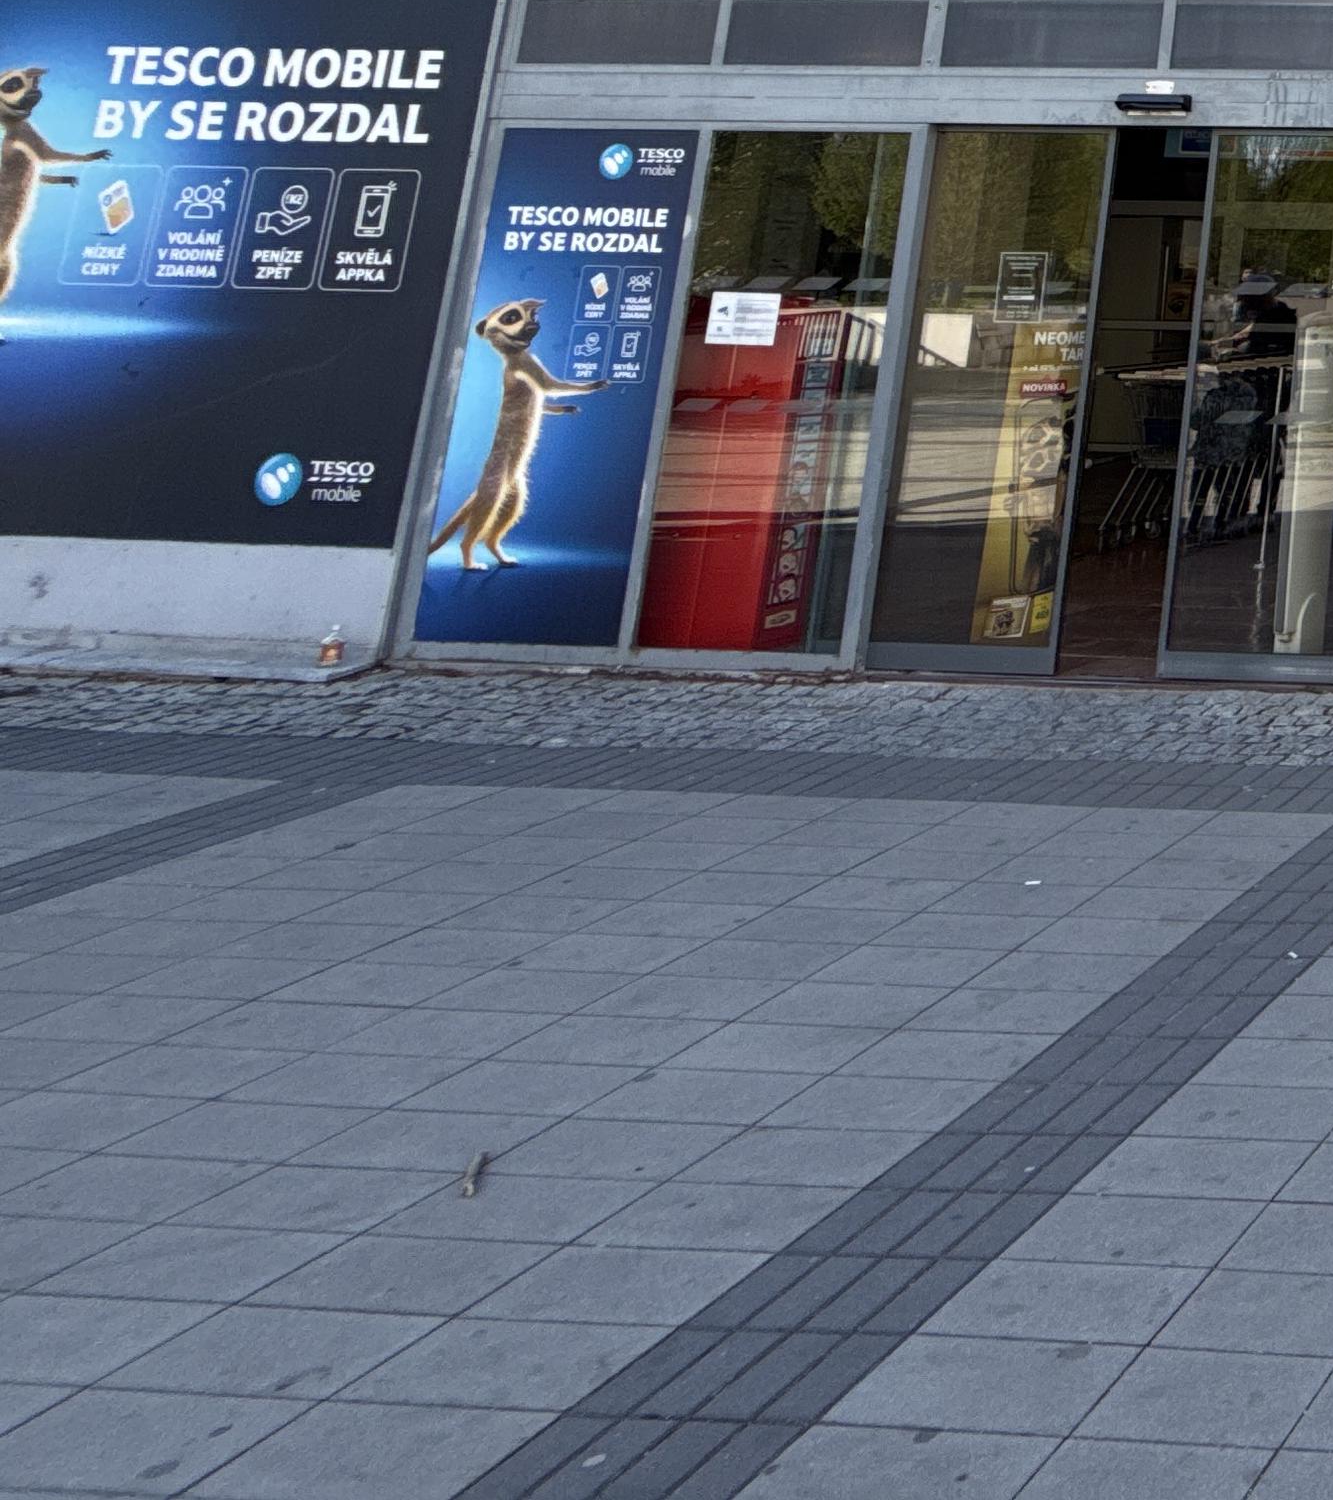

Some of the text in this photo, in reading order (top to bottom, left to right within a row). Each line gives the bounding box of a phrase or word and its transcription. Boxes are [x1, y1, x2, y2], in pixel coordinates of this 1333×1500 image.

[106, 46, 444, 90] TESCO MOBILE
[92, 99, 430, 144] BY SE ROZDAL
[638, 148, 685, 159] TESCO
[640, 164, 676, 176] mobile
[508, 206, 669, 227] TESCO MOBILE
[168, 229, 222, 245] VOLÁNÍ
[503, 231, 663, 253] BY SE ROZDAL
[158, 245, 225, 262] V RODINĚ
[251, 246, 304, 264] PENÍZE
[336, 247, 392, 266] SKVĚLÁ
[81, 262, 120, 277] CENY
[156, 264, 217, 278] ZDARMA
[255, 262, 292, 280] ZPĚT
[336, 268, 385, 282] APPKA
[1022, 382, 1066, 393] NOVINKA
[310, 460, 375, 477] TESCO
[311, 484, 361, 502] mobile
